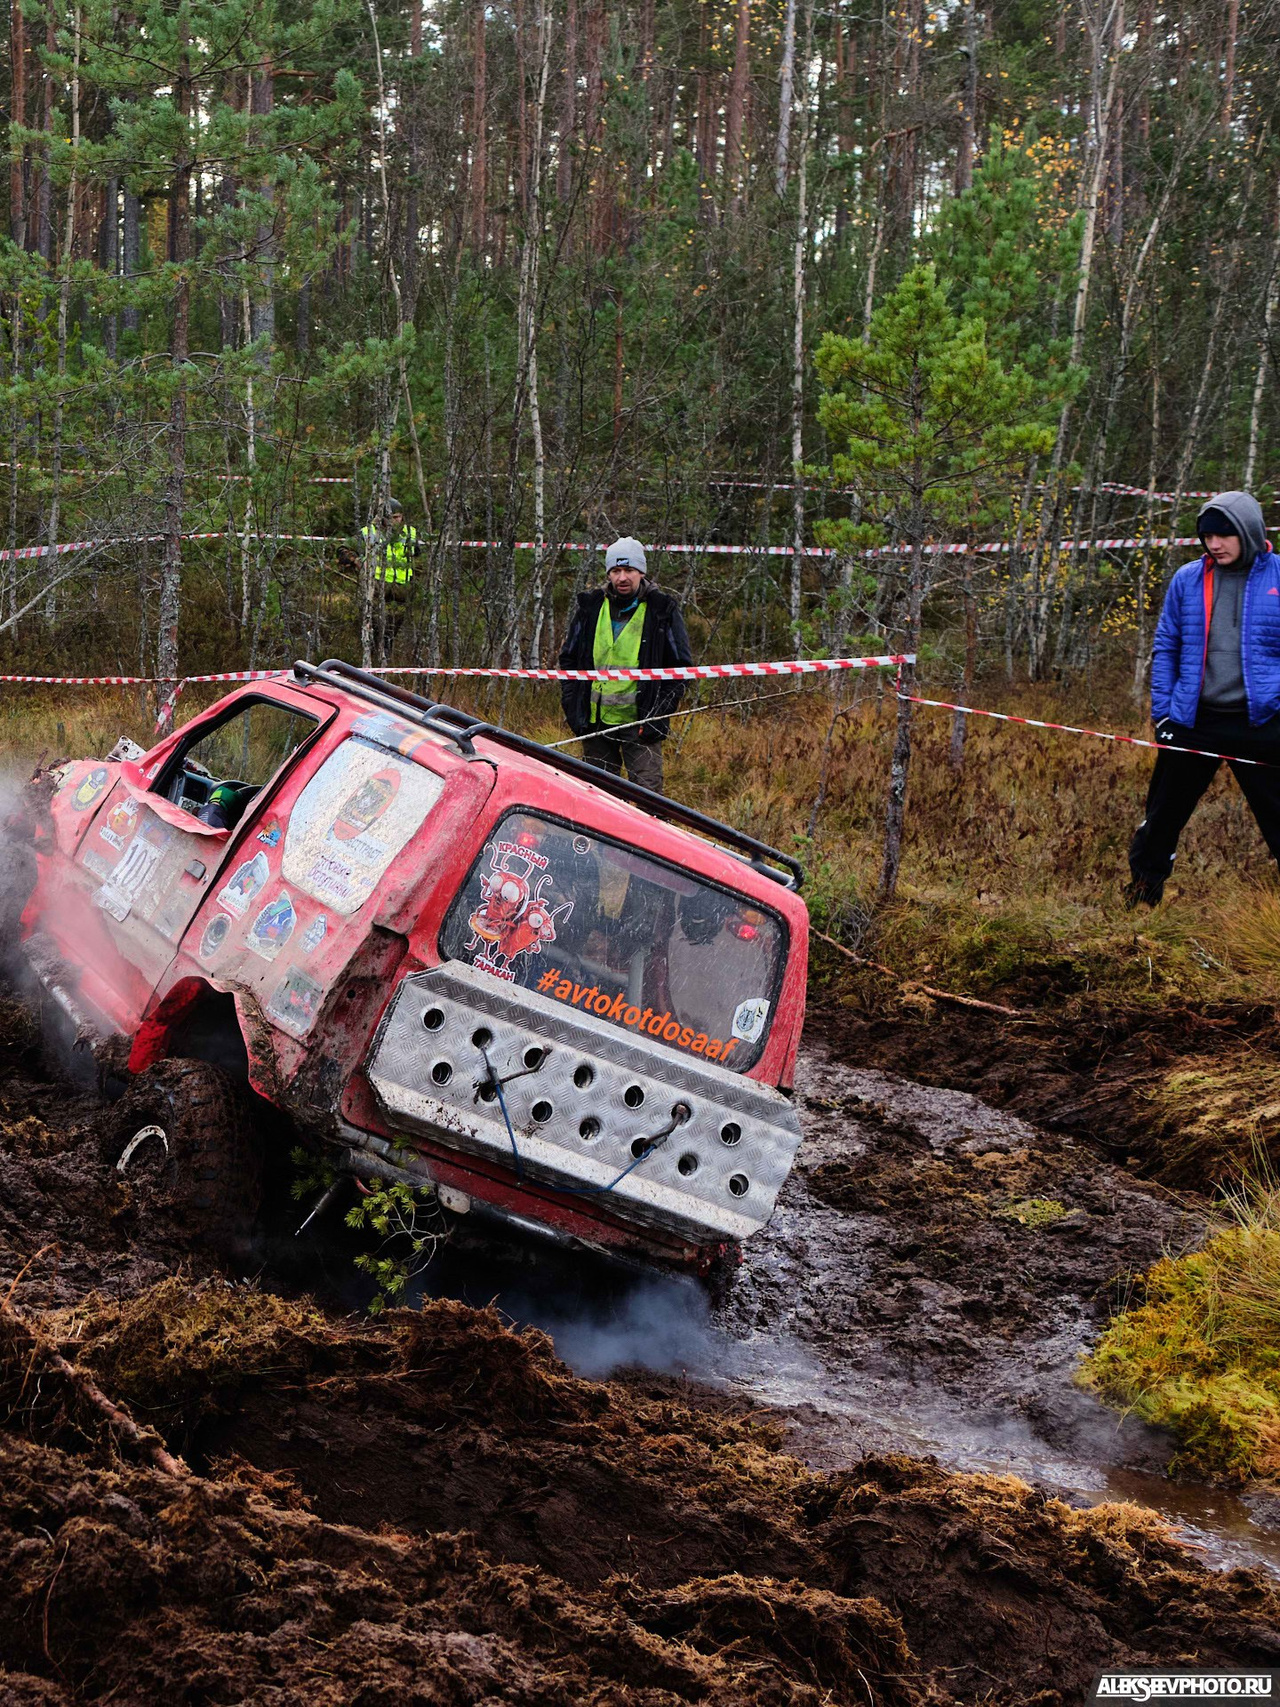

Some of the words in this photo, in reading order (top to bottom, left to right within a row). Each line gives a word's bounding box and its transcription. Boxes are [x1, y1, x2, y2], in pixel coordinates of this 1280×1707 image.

[112, 843, 158, 895] 101
[498, 841, 550, 870] КРАСНЫЙ
[473, 955, 515, 982] ТАРАКАН
[536, 968, 740, 1062] #avtokotdosaaf
